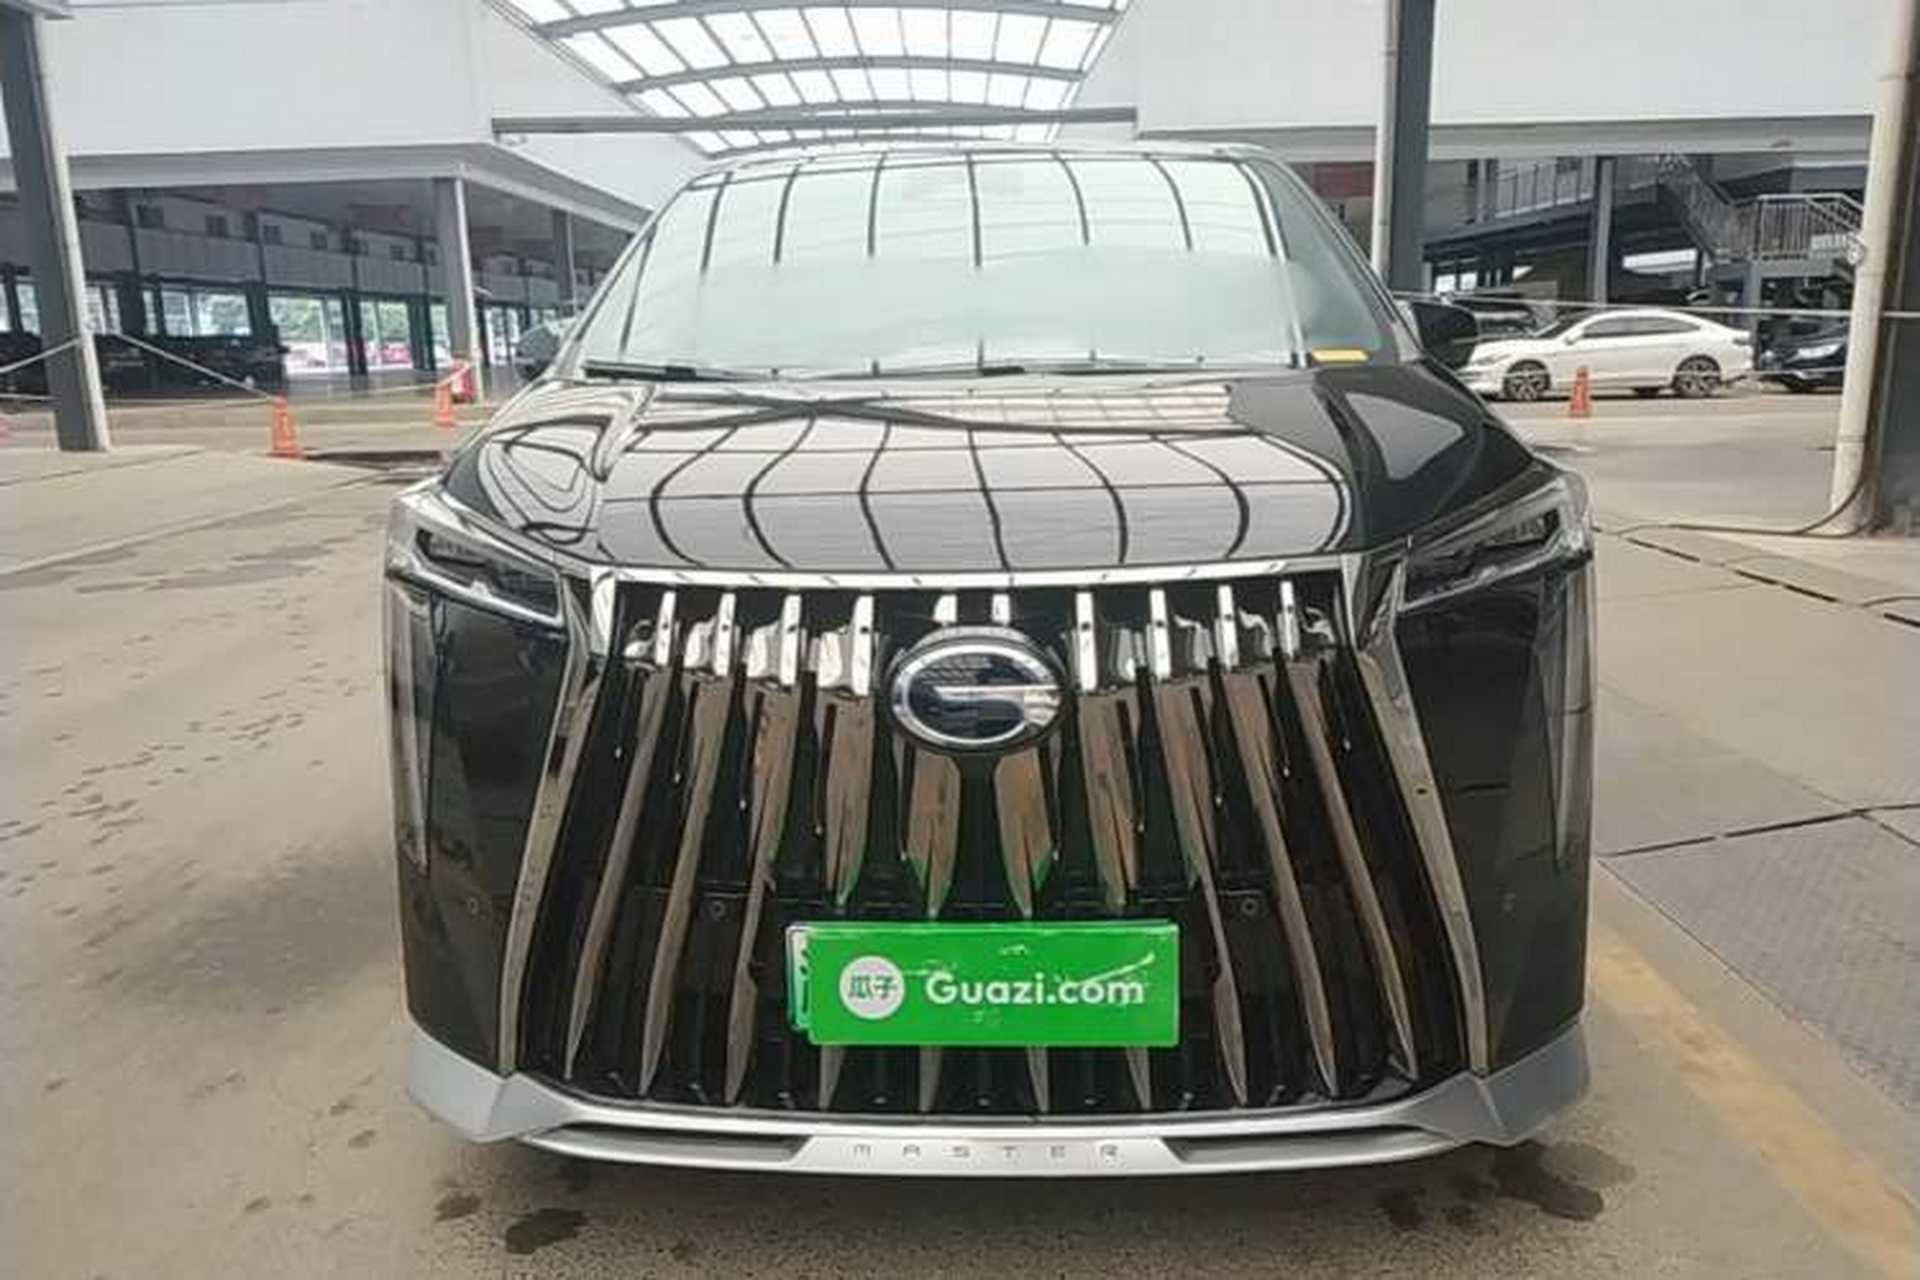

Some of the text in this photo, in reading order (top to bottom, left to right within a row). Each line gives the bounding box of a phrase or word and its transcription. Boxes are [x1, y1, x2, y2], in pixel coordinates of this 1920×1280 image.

[848, 975, 899, 1000] 瓜子
[925, 971, 1145, 1005] Guazi.com
[853, 1143, 1119, 1160] MASTER
